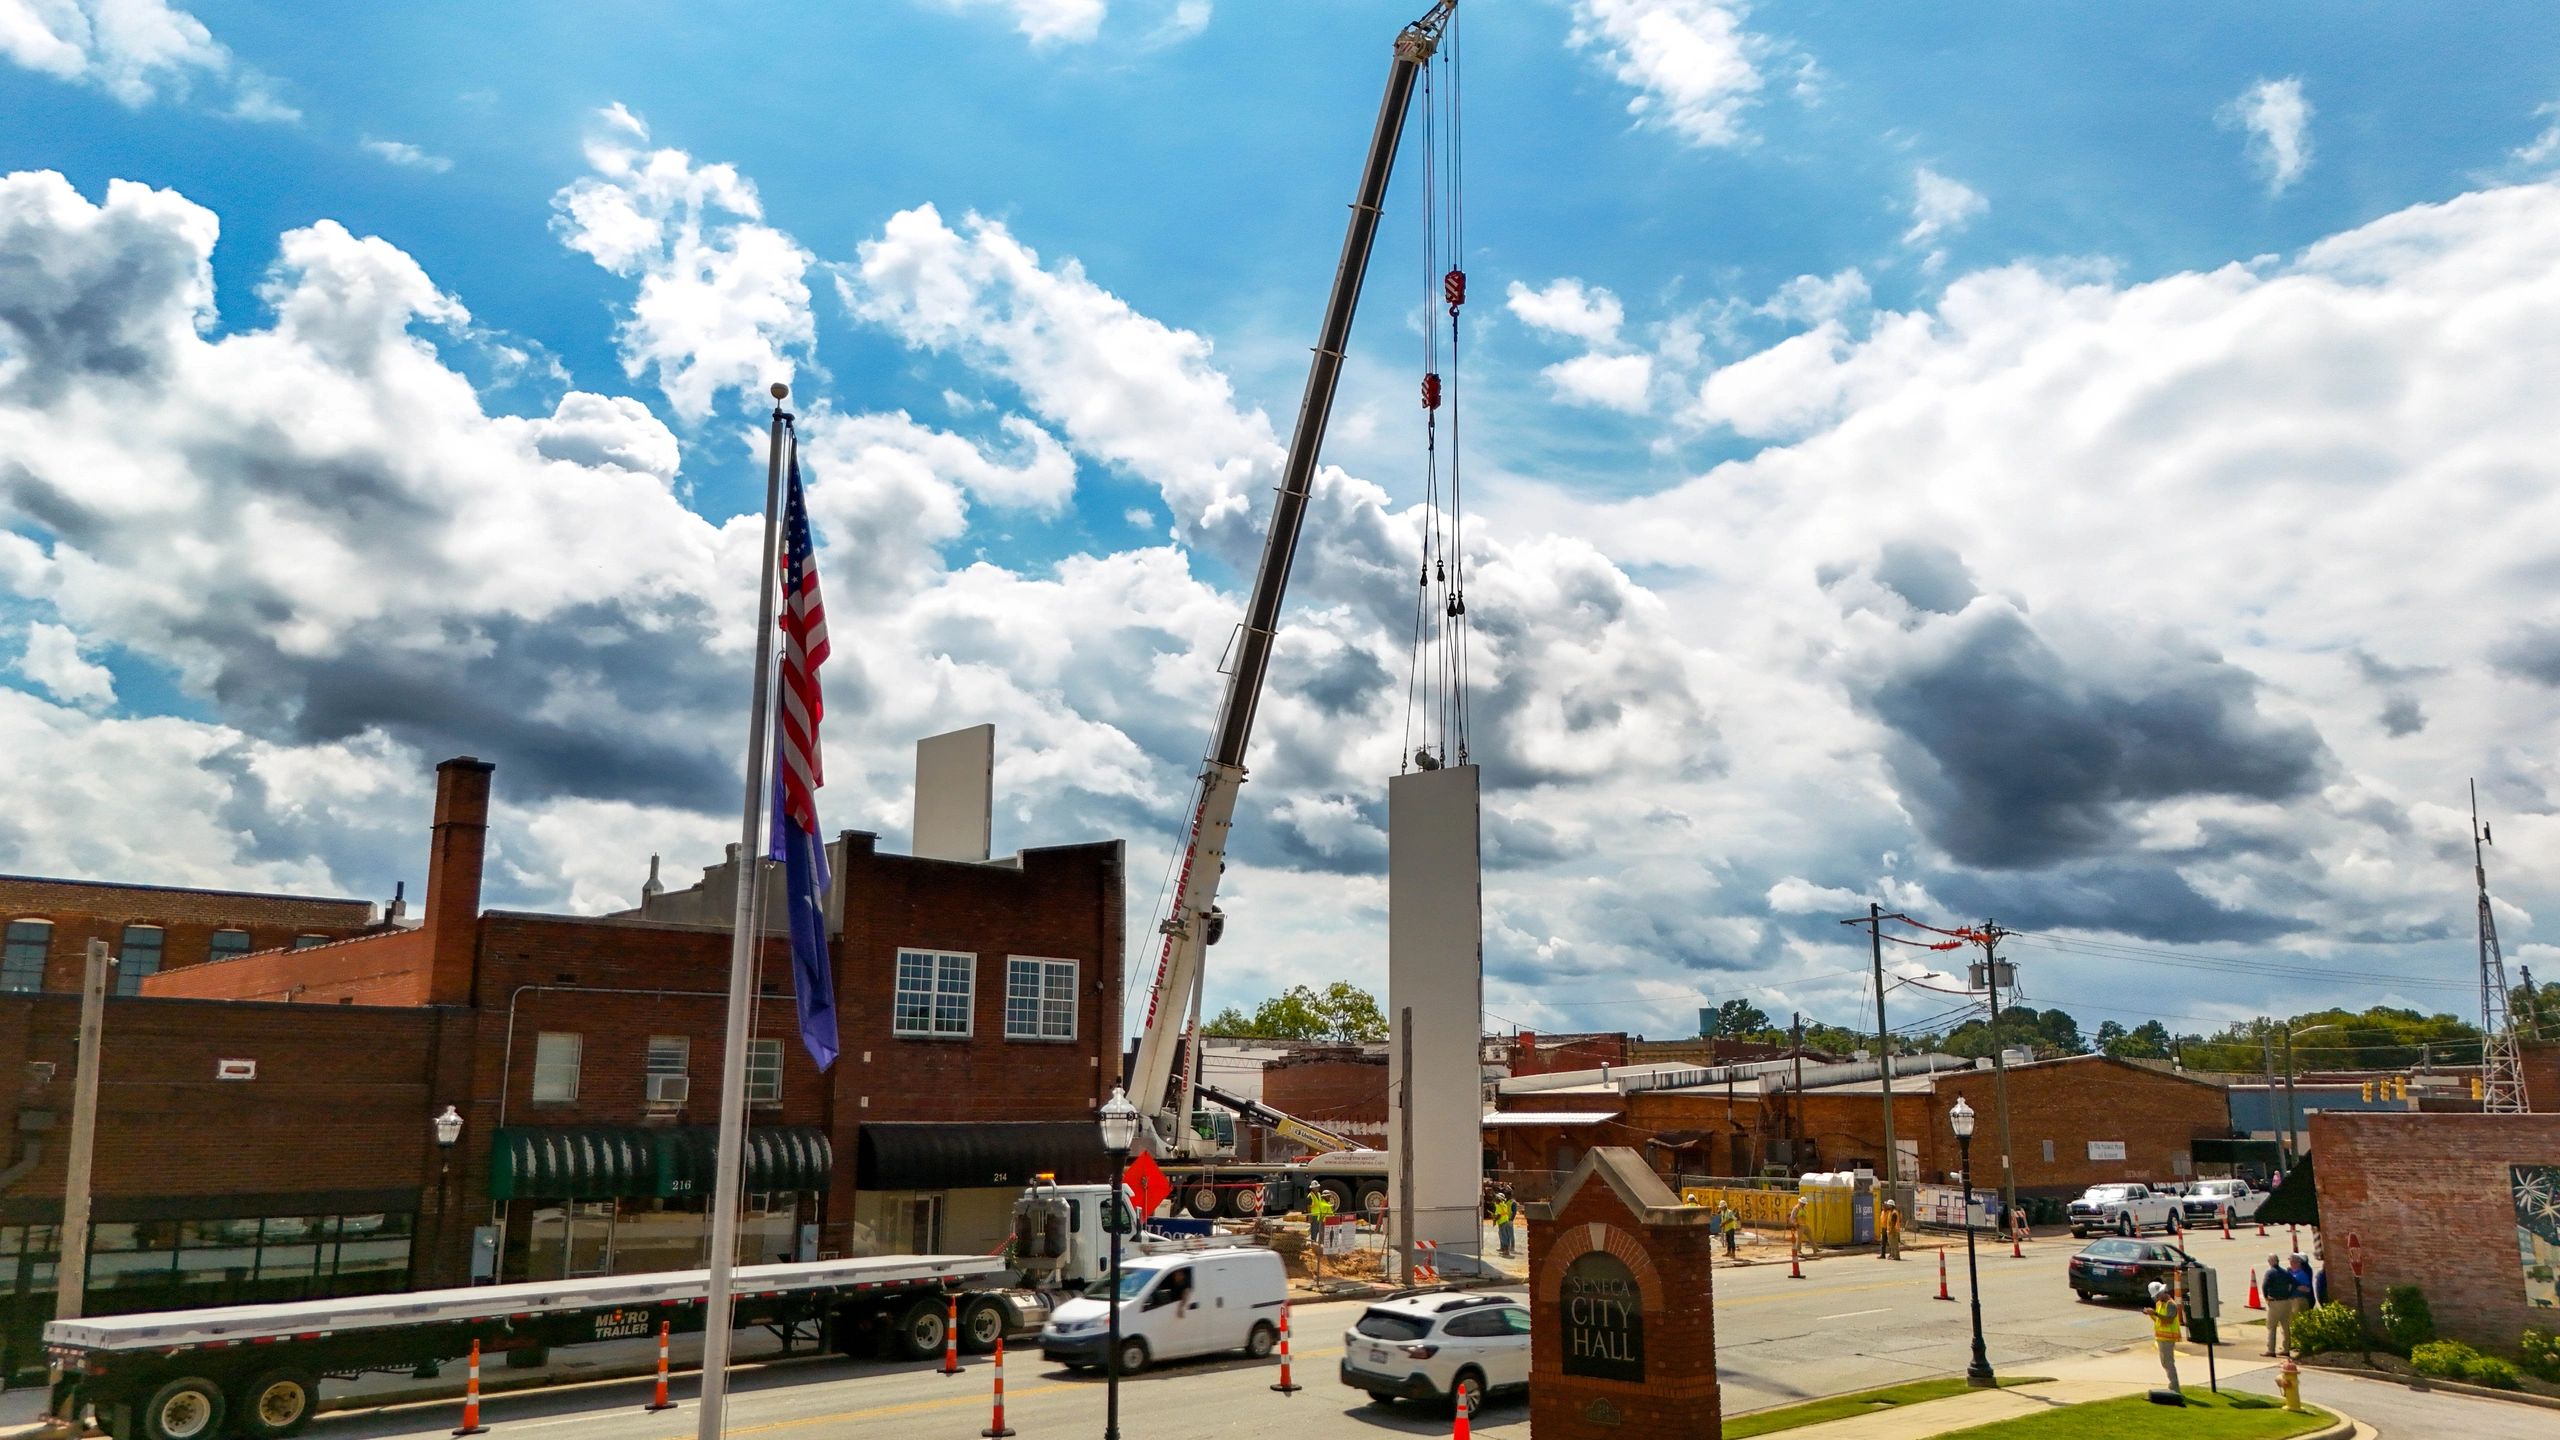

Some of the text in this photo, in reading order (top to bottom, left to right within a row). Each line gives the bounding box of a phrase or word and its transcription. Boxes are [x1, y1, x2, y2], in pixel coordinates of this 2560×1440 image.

[672, 1179, 692, 1190] 216
[993, 1172, 1008, 1182] 214
[1572, 1275, 1631, 1297] SENECA
[1571, 1296, 1633, 1329] CITY
[595, 1322, 649, 1338] TRAILER
[1573, 1328, 1635, 1361] HALL
